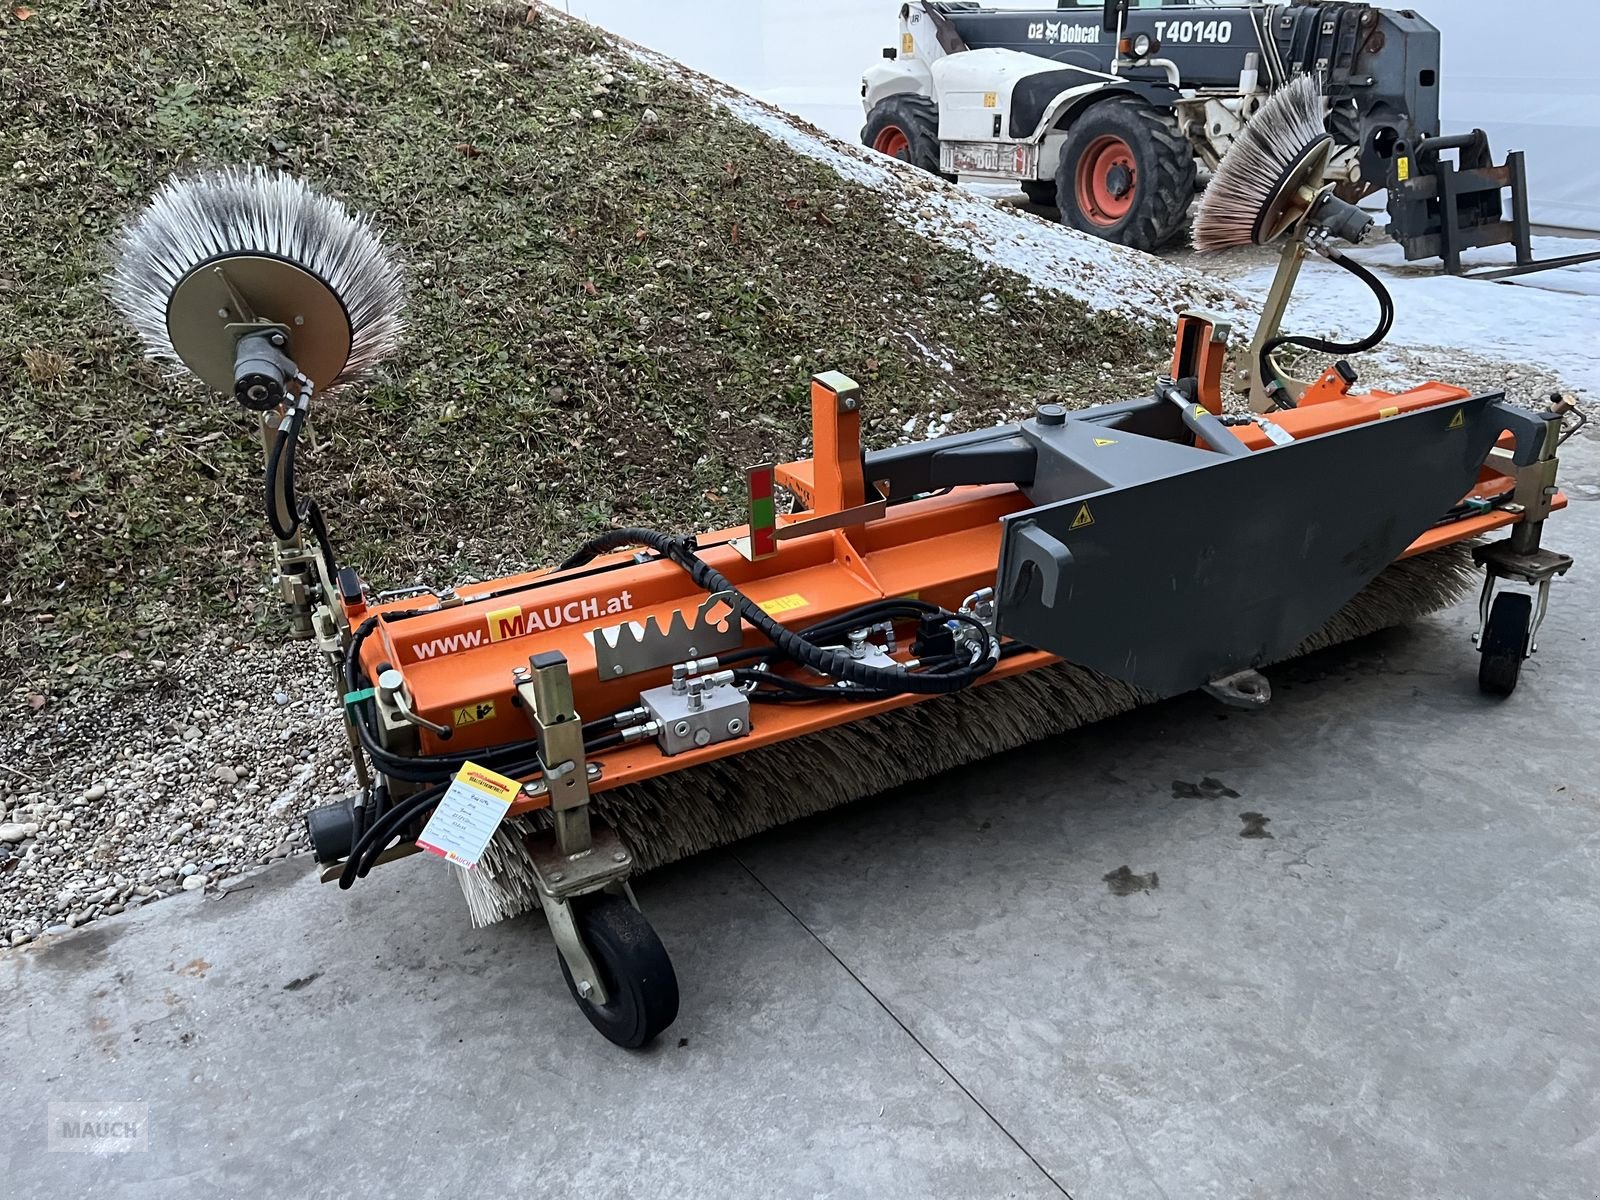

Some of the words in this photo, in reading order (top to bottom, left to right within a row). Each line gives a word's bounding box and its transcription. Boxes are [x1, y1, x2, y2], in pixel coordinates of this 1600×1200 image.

[1060, 24, 1100, 43] Bobcat
[1154, 21, 1232, 43] T40140
[412, 590, 633, 660] www.MAUCH.at
